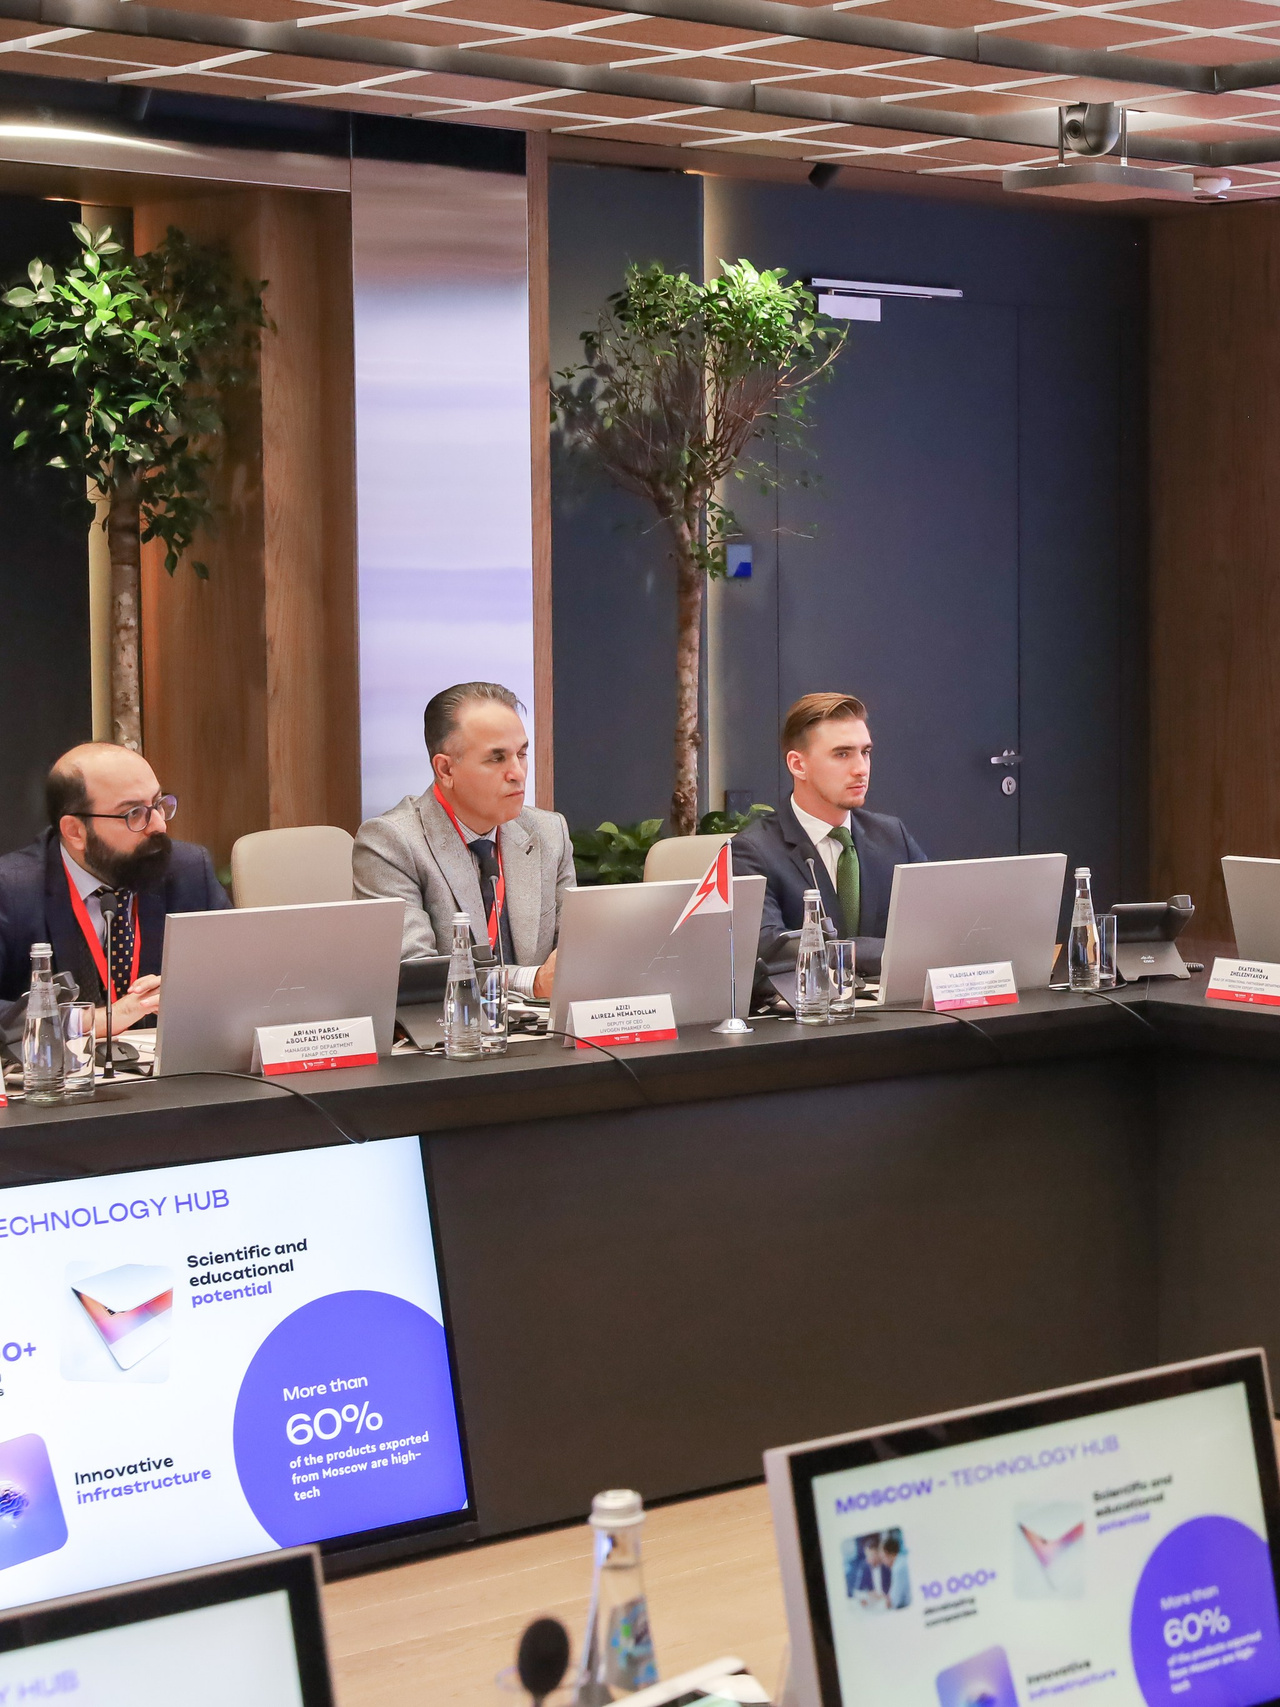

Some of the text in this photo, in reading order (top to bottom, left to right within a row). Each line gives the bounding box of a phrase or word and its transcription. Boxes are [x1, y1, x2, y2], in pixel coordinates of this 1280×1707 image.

[590, 1012, 615, 1020] ALIREZA
[293, 1028, 317, 1037] ARIANI
[320, 1032, 350, 1041] HOSSEIN
[284, 1046, 311, 1054] MANAGER
[320, 1042, 353, 1050] DEPARTMENT
[175, 1188, 230, 1214] HUB
[187, 1238, 308, 1268] Scientific and
[189, 1259, 294, 1287] educational
[191, 1281, 272, 1308] potential
[283, 1376, 369, 1402] More than
[286, 1400, 383, 1446] 60%
[289, 1430, 429, 1469] of the products exported
[75, 1457, 174, 1485] Innovative
[291, 1471, 319, 1485] from
[322, 1461, 368, 1479] Moscow
[371, 1457, 389, 1469] are
[835, 1478, 934, 1516] MOSCOW
[951, 1443, 1078, 1488] TECHNOLOGY
[1083, 1434, 1119, 1458] HUB
[76, 1469, 212, 1505] infrastructure
[294, 1485, 321, 1501] tech
[920, 1568, 998, 1601] 10 000+
[1163, 1605, 1231, 1648] 60%
